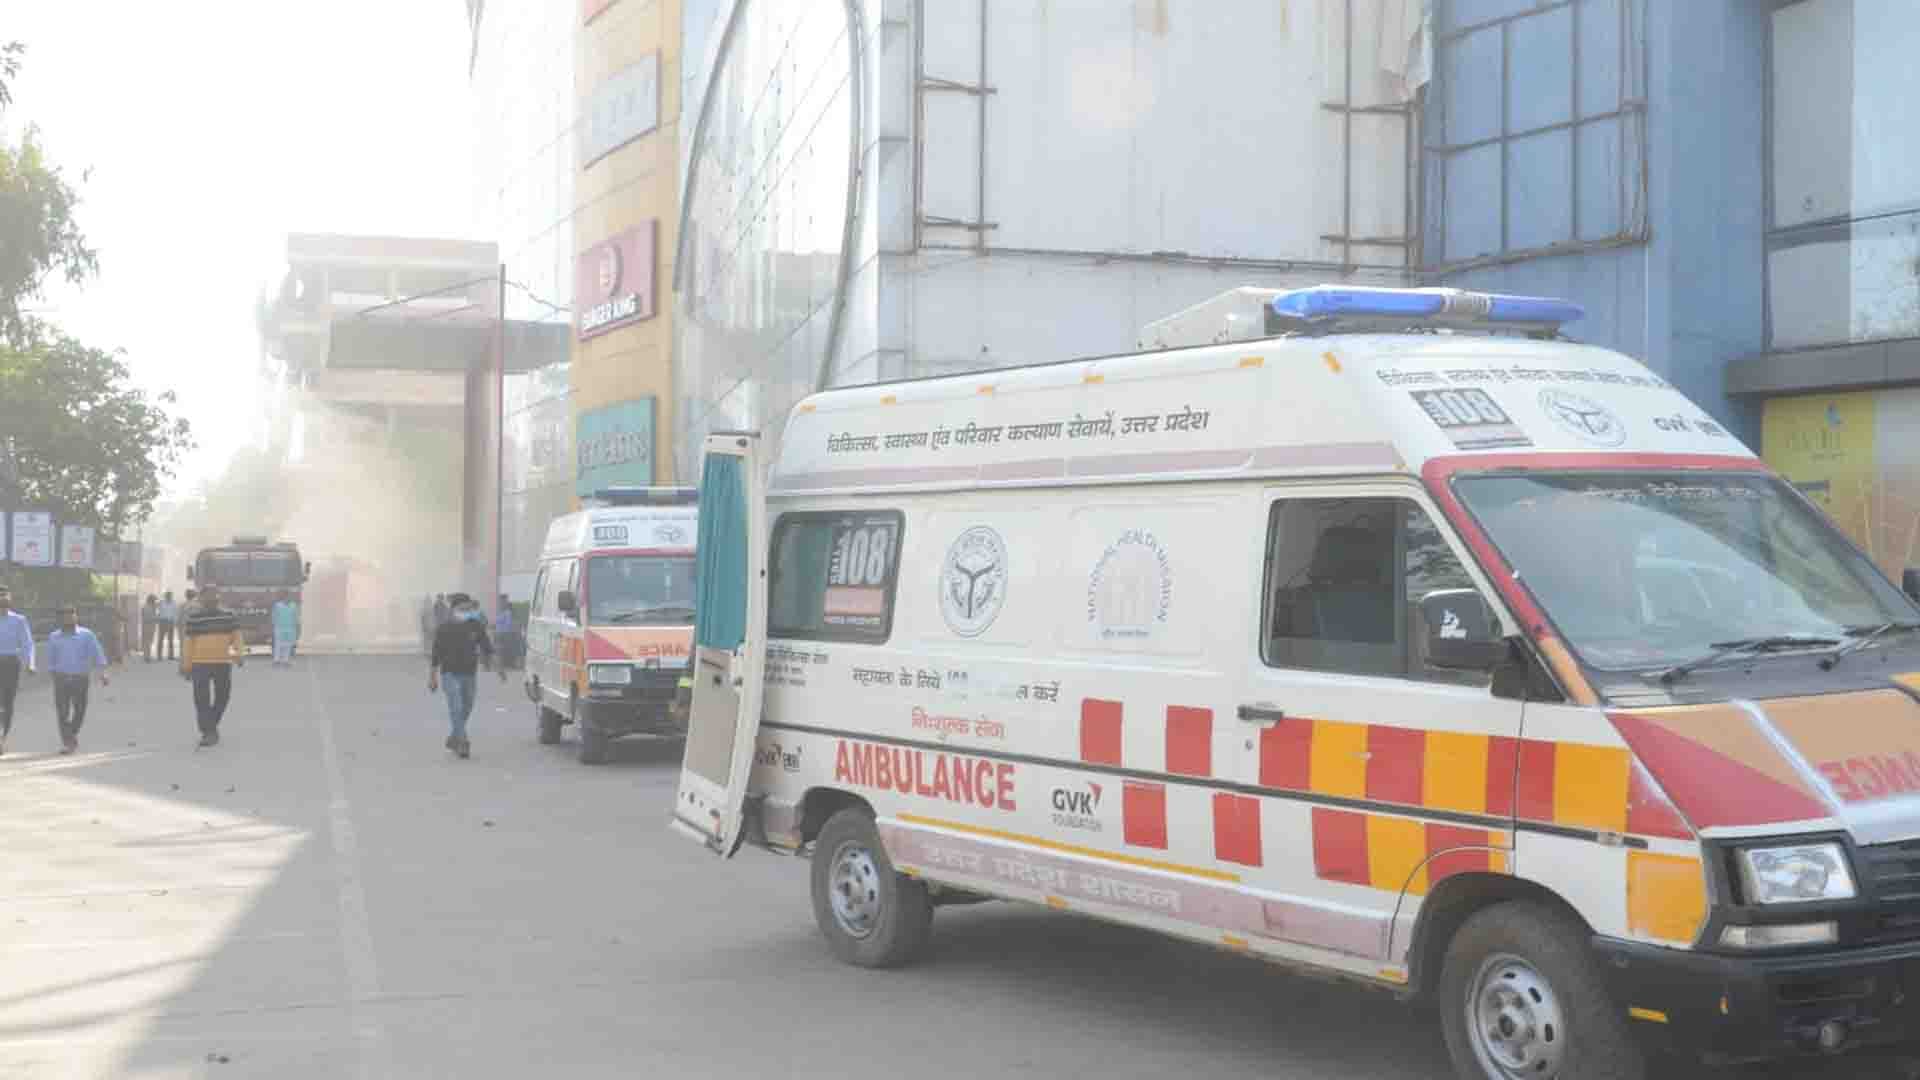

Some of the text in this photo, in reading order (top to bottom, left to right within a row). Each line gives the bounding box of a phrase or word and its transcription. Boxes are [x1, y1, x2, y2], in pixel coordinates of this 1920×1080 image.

[954, 422, 1002, 447] परिवार
[1008, 421, 1064, 441] कल्याण
[1121, 415, 1160, 434] उत्तर
[1164, 404, 1210, 432] प्रदेश
[838, 527, 889, 585] 108
[899, 667, 912, 687] के
[834, 739, 1017, 812] AMBULANCE
[1051, 787, 1093, 815] GVK
